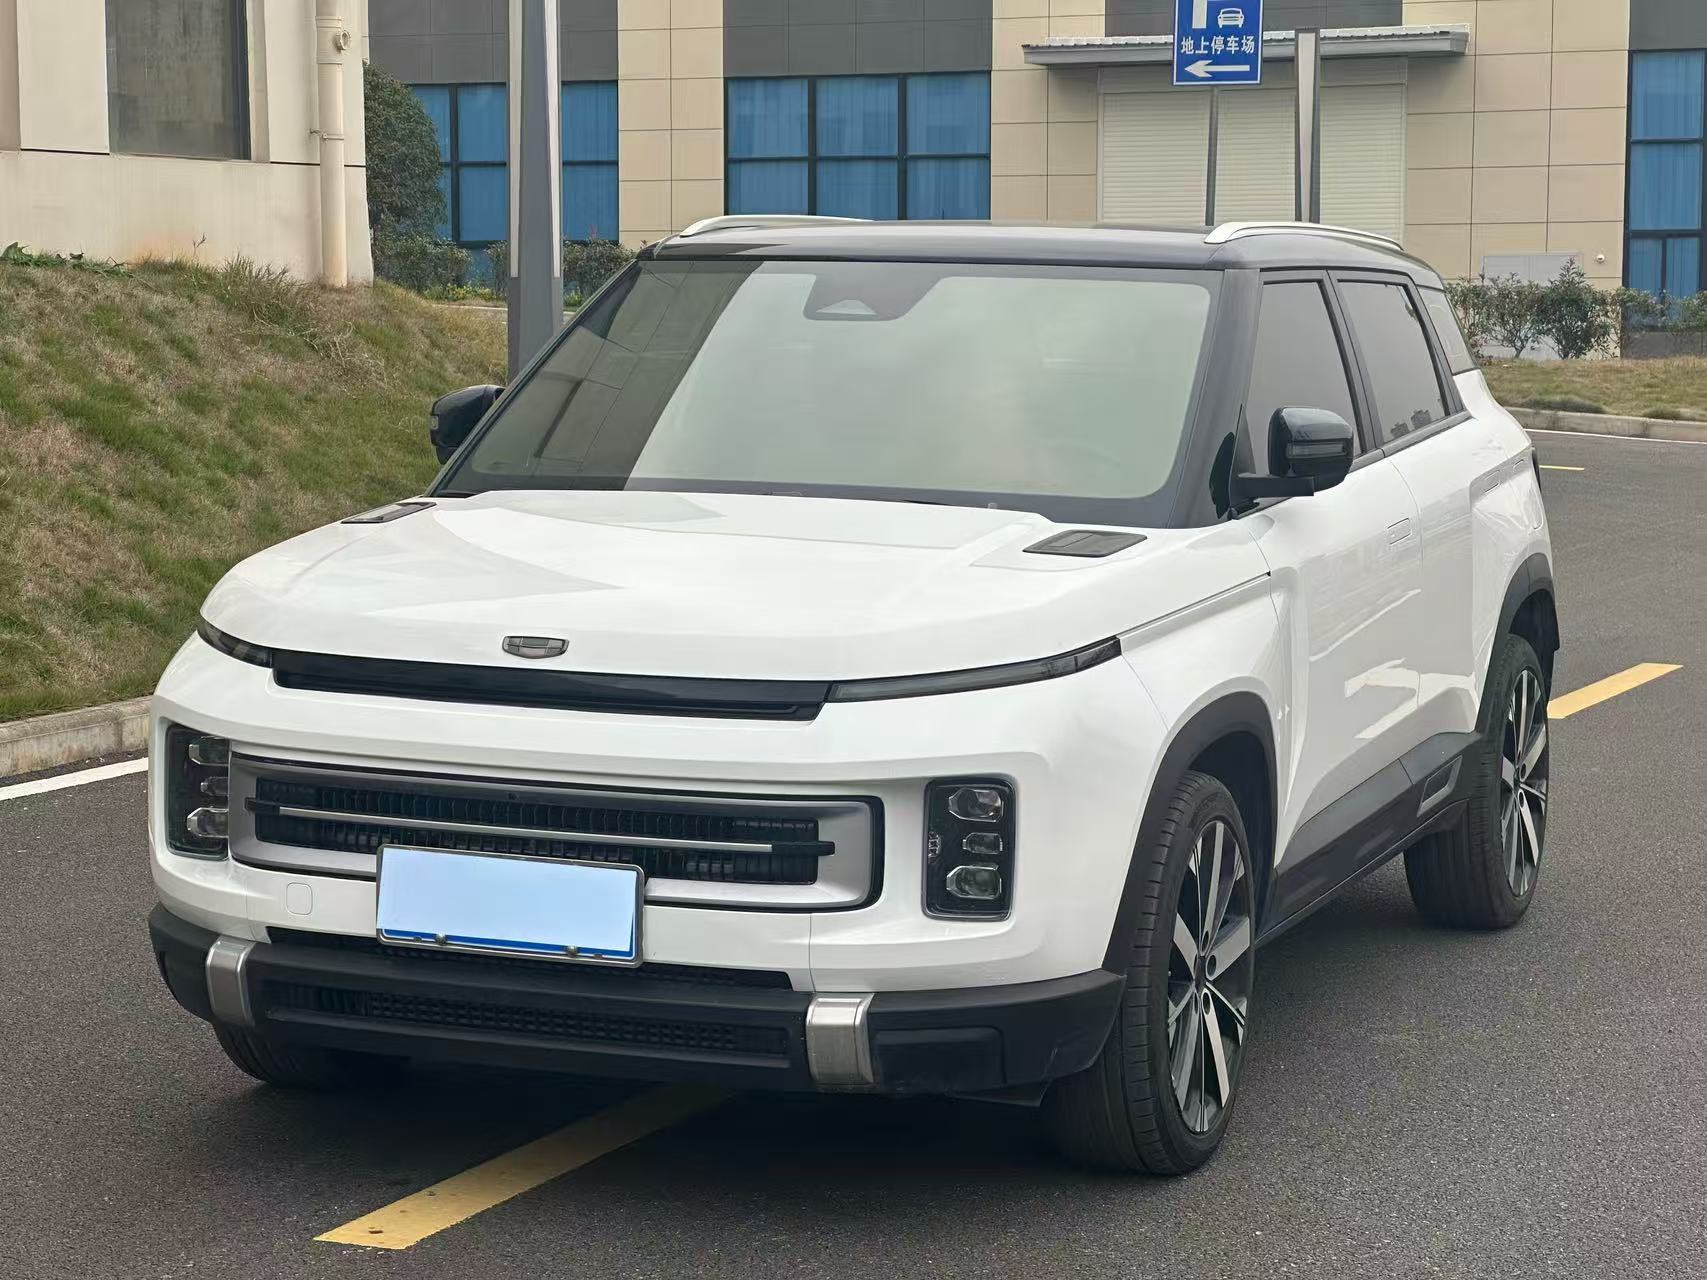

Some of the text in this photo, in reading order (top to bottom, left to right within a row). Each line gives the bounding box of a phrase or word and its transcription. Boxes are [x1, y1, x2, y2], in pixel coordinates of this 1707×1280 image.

[1181, 35, 1255, 55] 地上停车场
